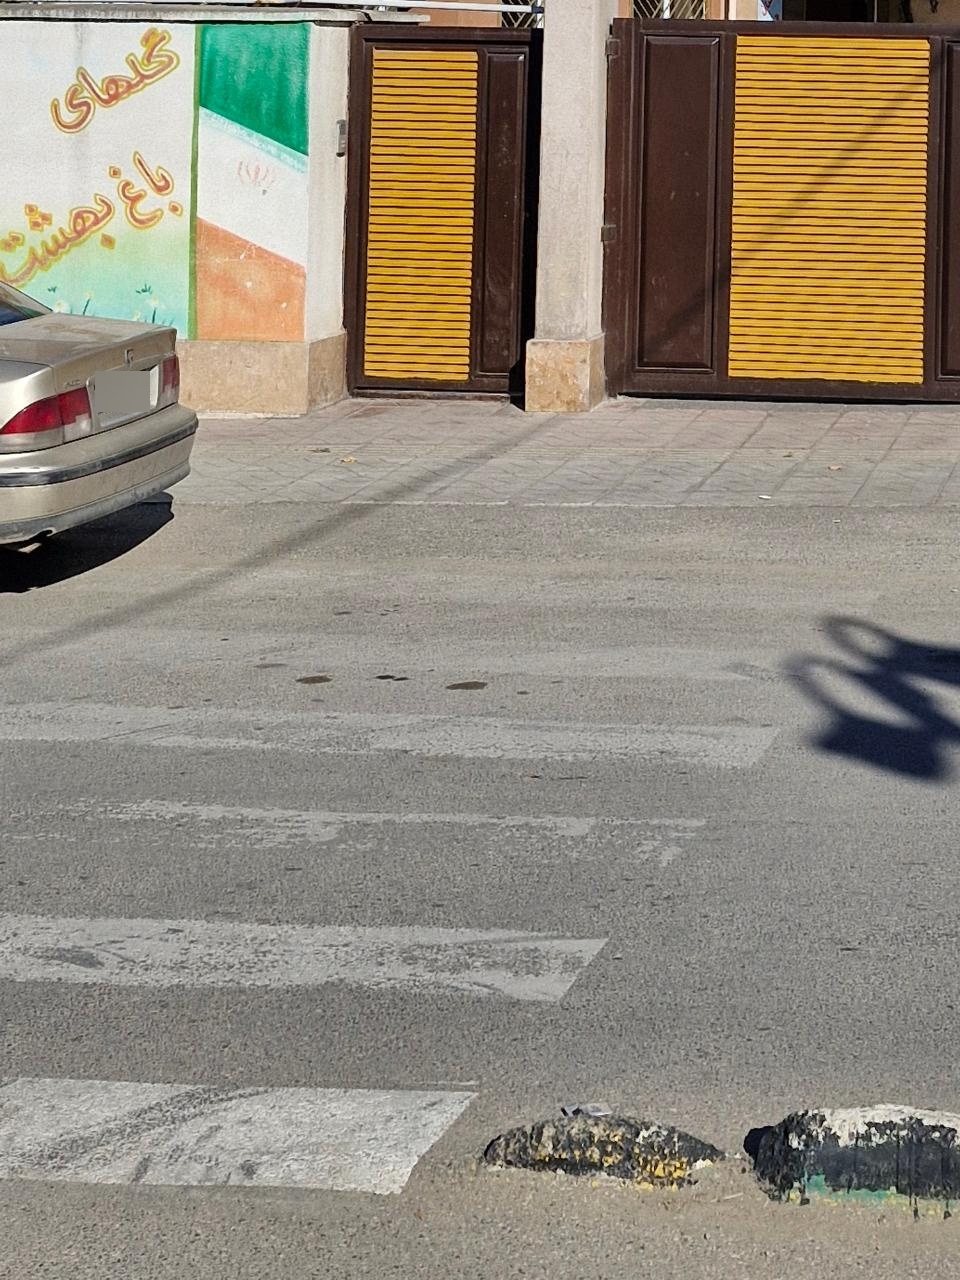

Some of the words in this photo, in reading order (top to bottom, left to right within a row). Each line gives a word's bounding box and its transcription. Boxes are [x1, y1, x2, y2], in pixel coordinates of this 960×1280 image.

[51, 27, 180, 133] گلهای
[109, 151, 183, 230] باغ
[0, 192, 116, 288] بهشت
